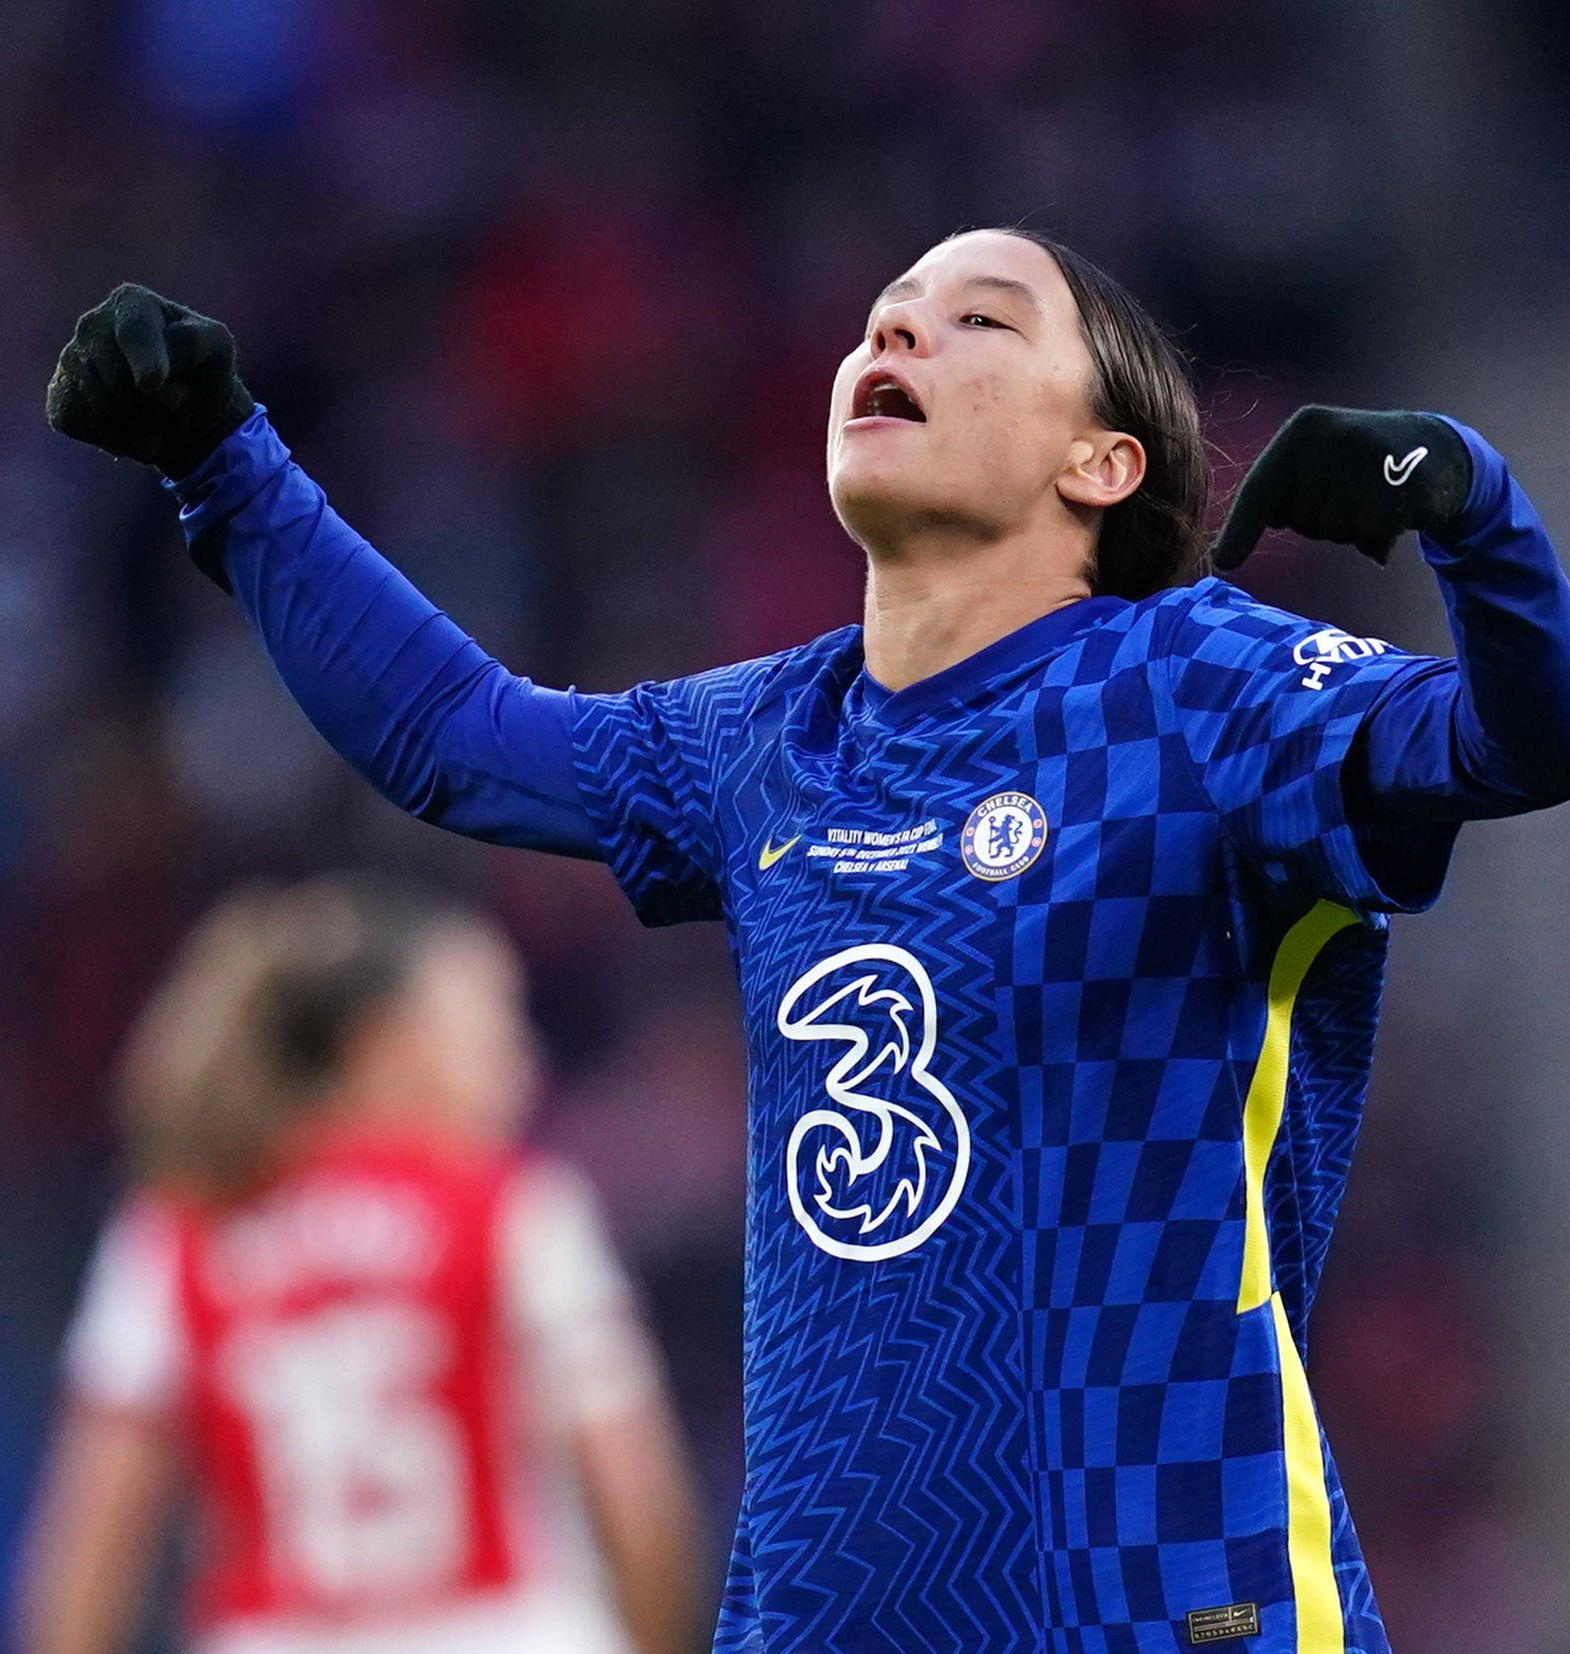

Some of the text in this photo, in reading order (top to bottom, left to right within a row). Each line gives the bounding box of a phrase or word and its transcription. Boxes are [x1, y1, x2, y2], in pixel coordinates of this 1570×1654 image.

[1301, 637, 1394, 691] HYUN
[977, 795, 1033, 817] CHELSEA
[827, 828, 863, 844] VITALITY
[910, 825, 924, 841] CUP
[806, 845, 841, 858] SUNDAY
[855, 847, 898, 860] DECEMBER
[833, 860, 869, 874] CHELSEA
[874, 858, 909, 872] ARSENAL
[777, 943, 971, 1262] 3
